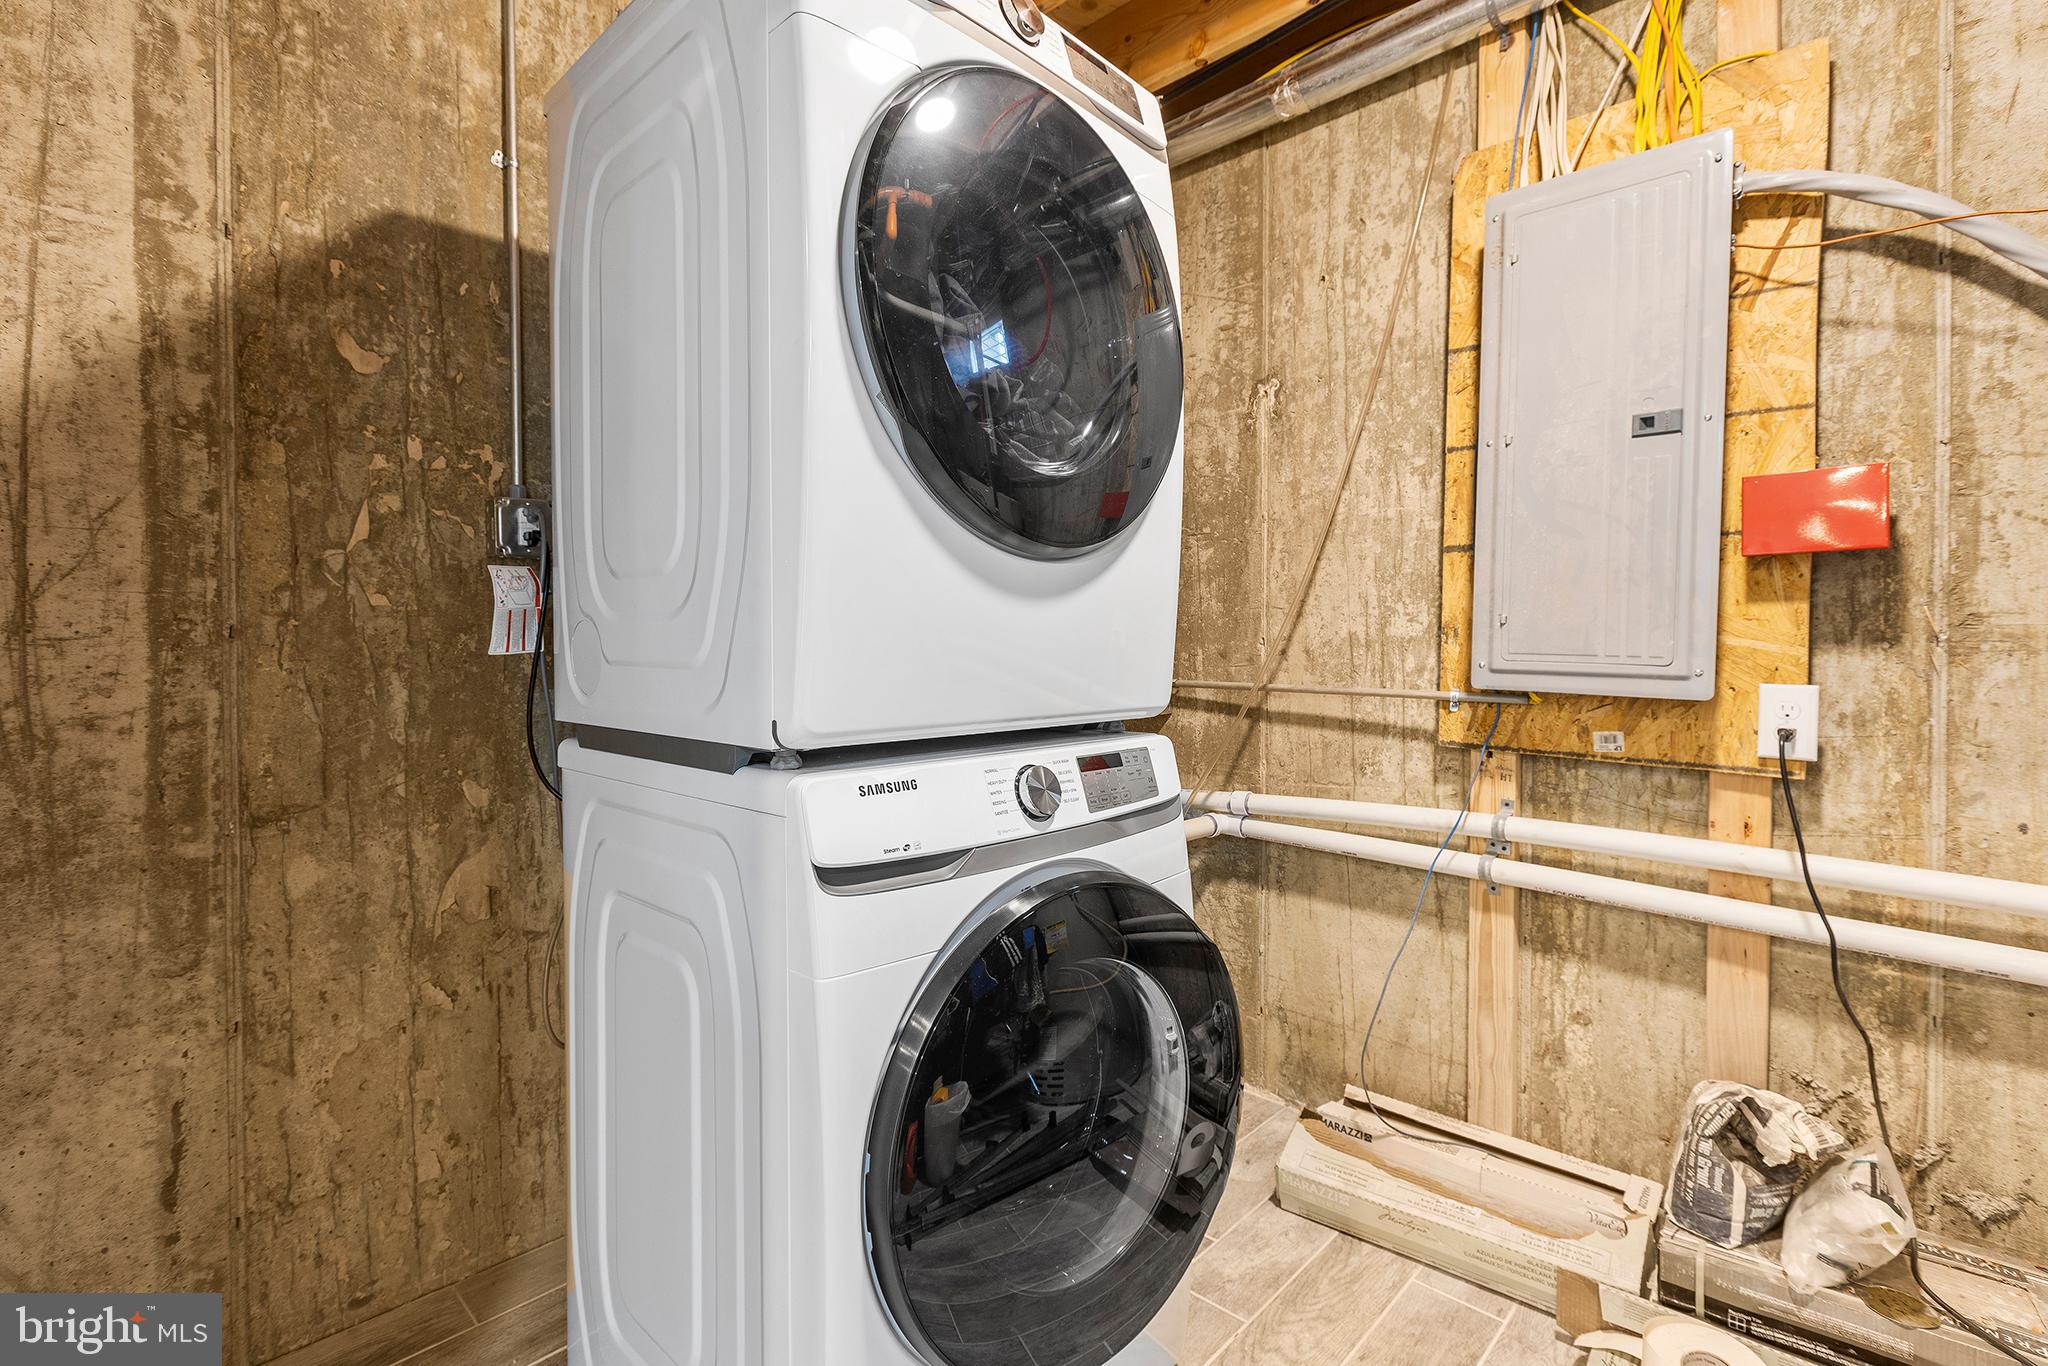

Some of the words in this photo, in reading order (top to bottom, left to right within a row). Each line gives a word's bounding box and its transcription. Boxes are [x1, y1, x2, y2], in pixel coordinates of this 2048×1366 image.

[858, 779, 918, 797] SAMSUNG
[883, 847, 901, 855] Steam
[1696, 1155, 1713, 1189] Grout
